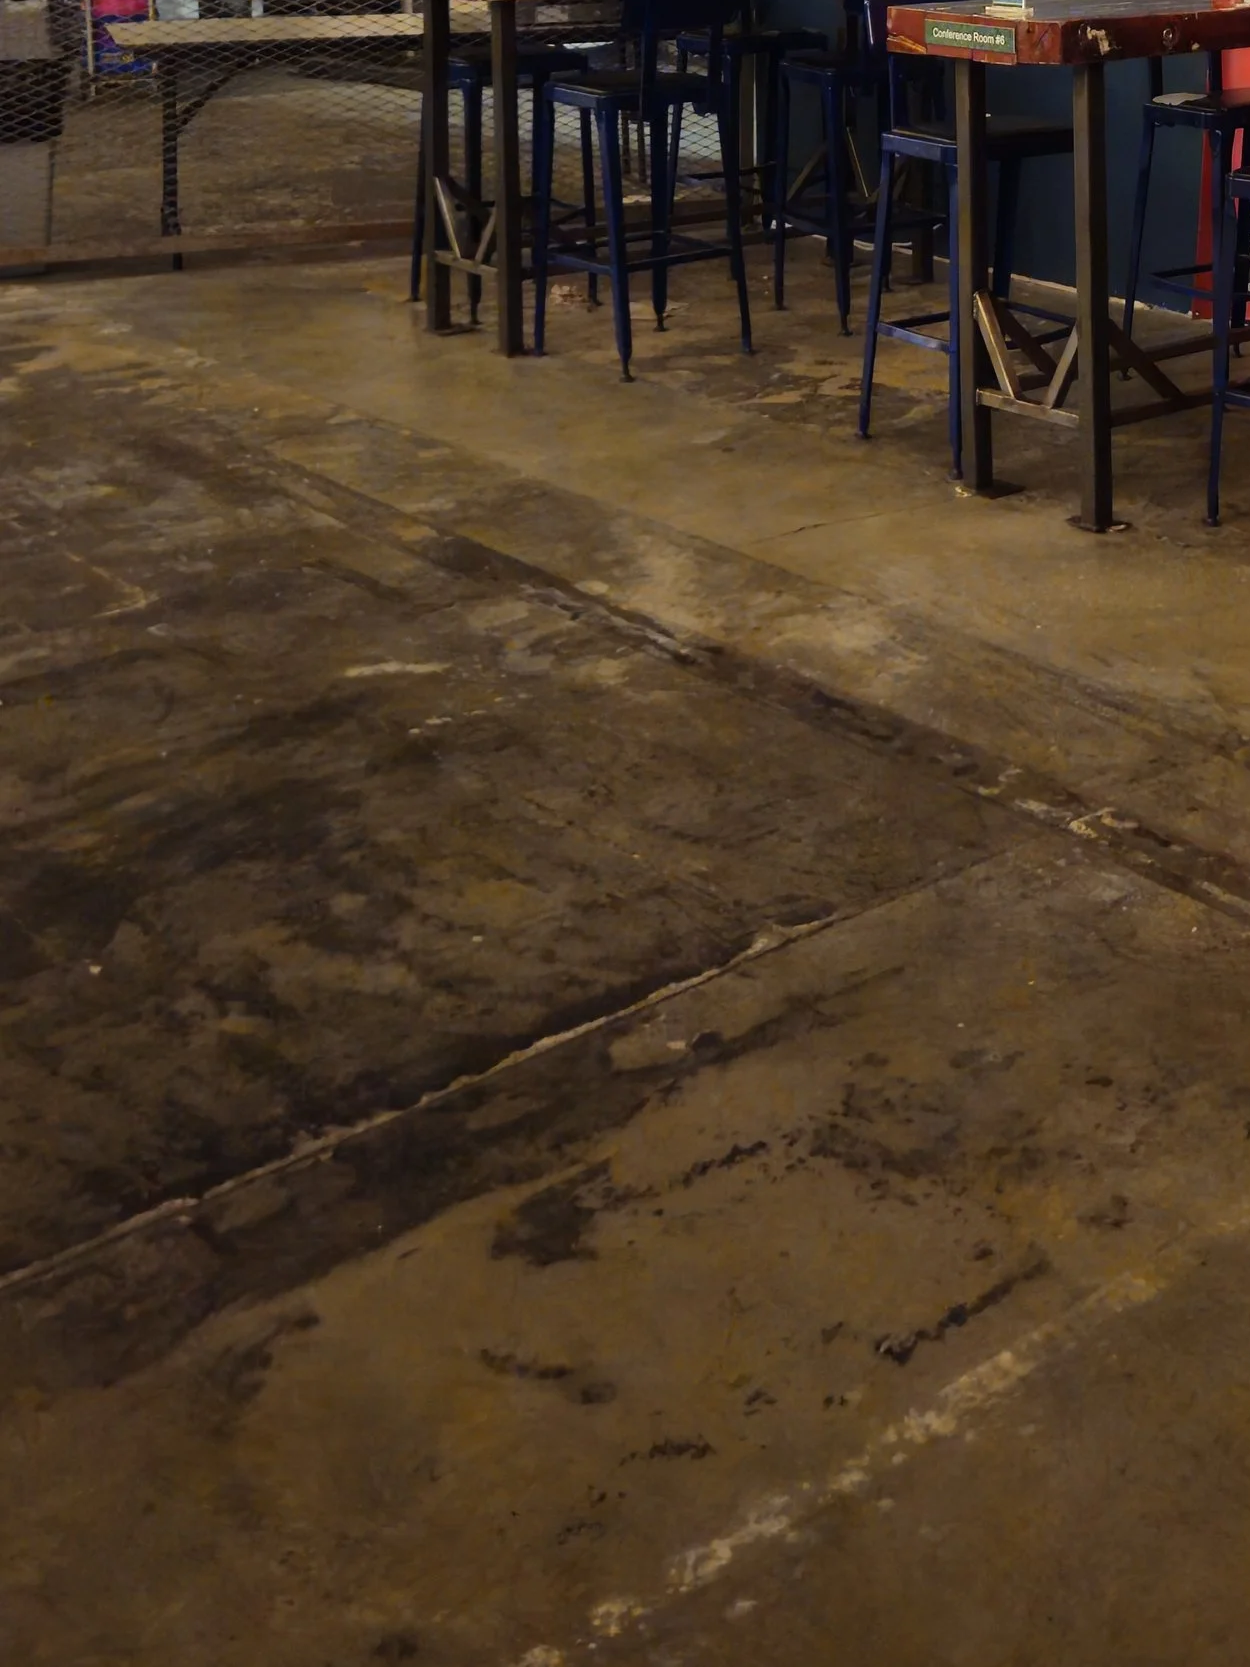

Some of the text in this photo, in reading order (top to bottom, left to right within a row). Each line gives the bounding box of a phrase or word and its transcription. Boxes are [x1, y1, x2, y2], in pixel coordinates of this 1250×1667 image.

[932, 26, 1005, 46] Conference Room #6
